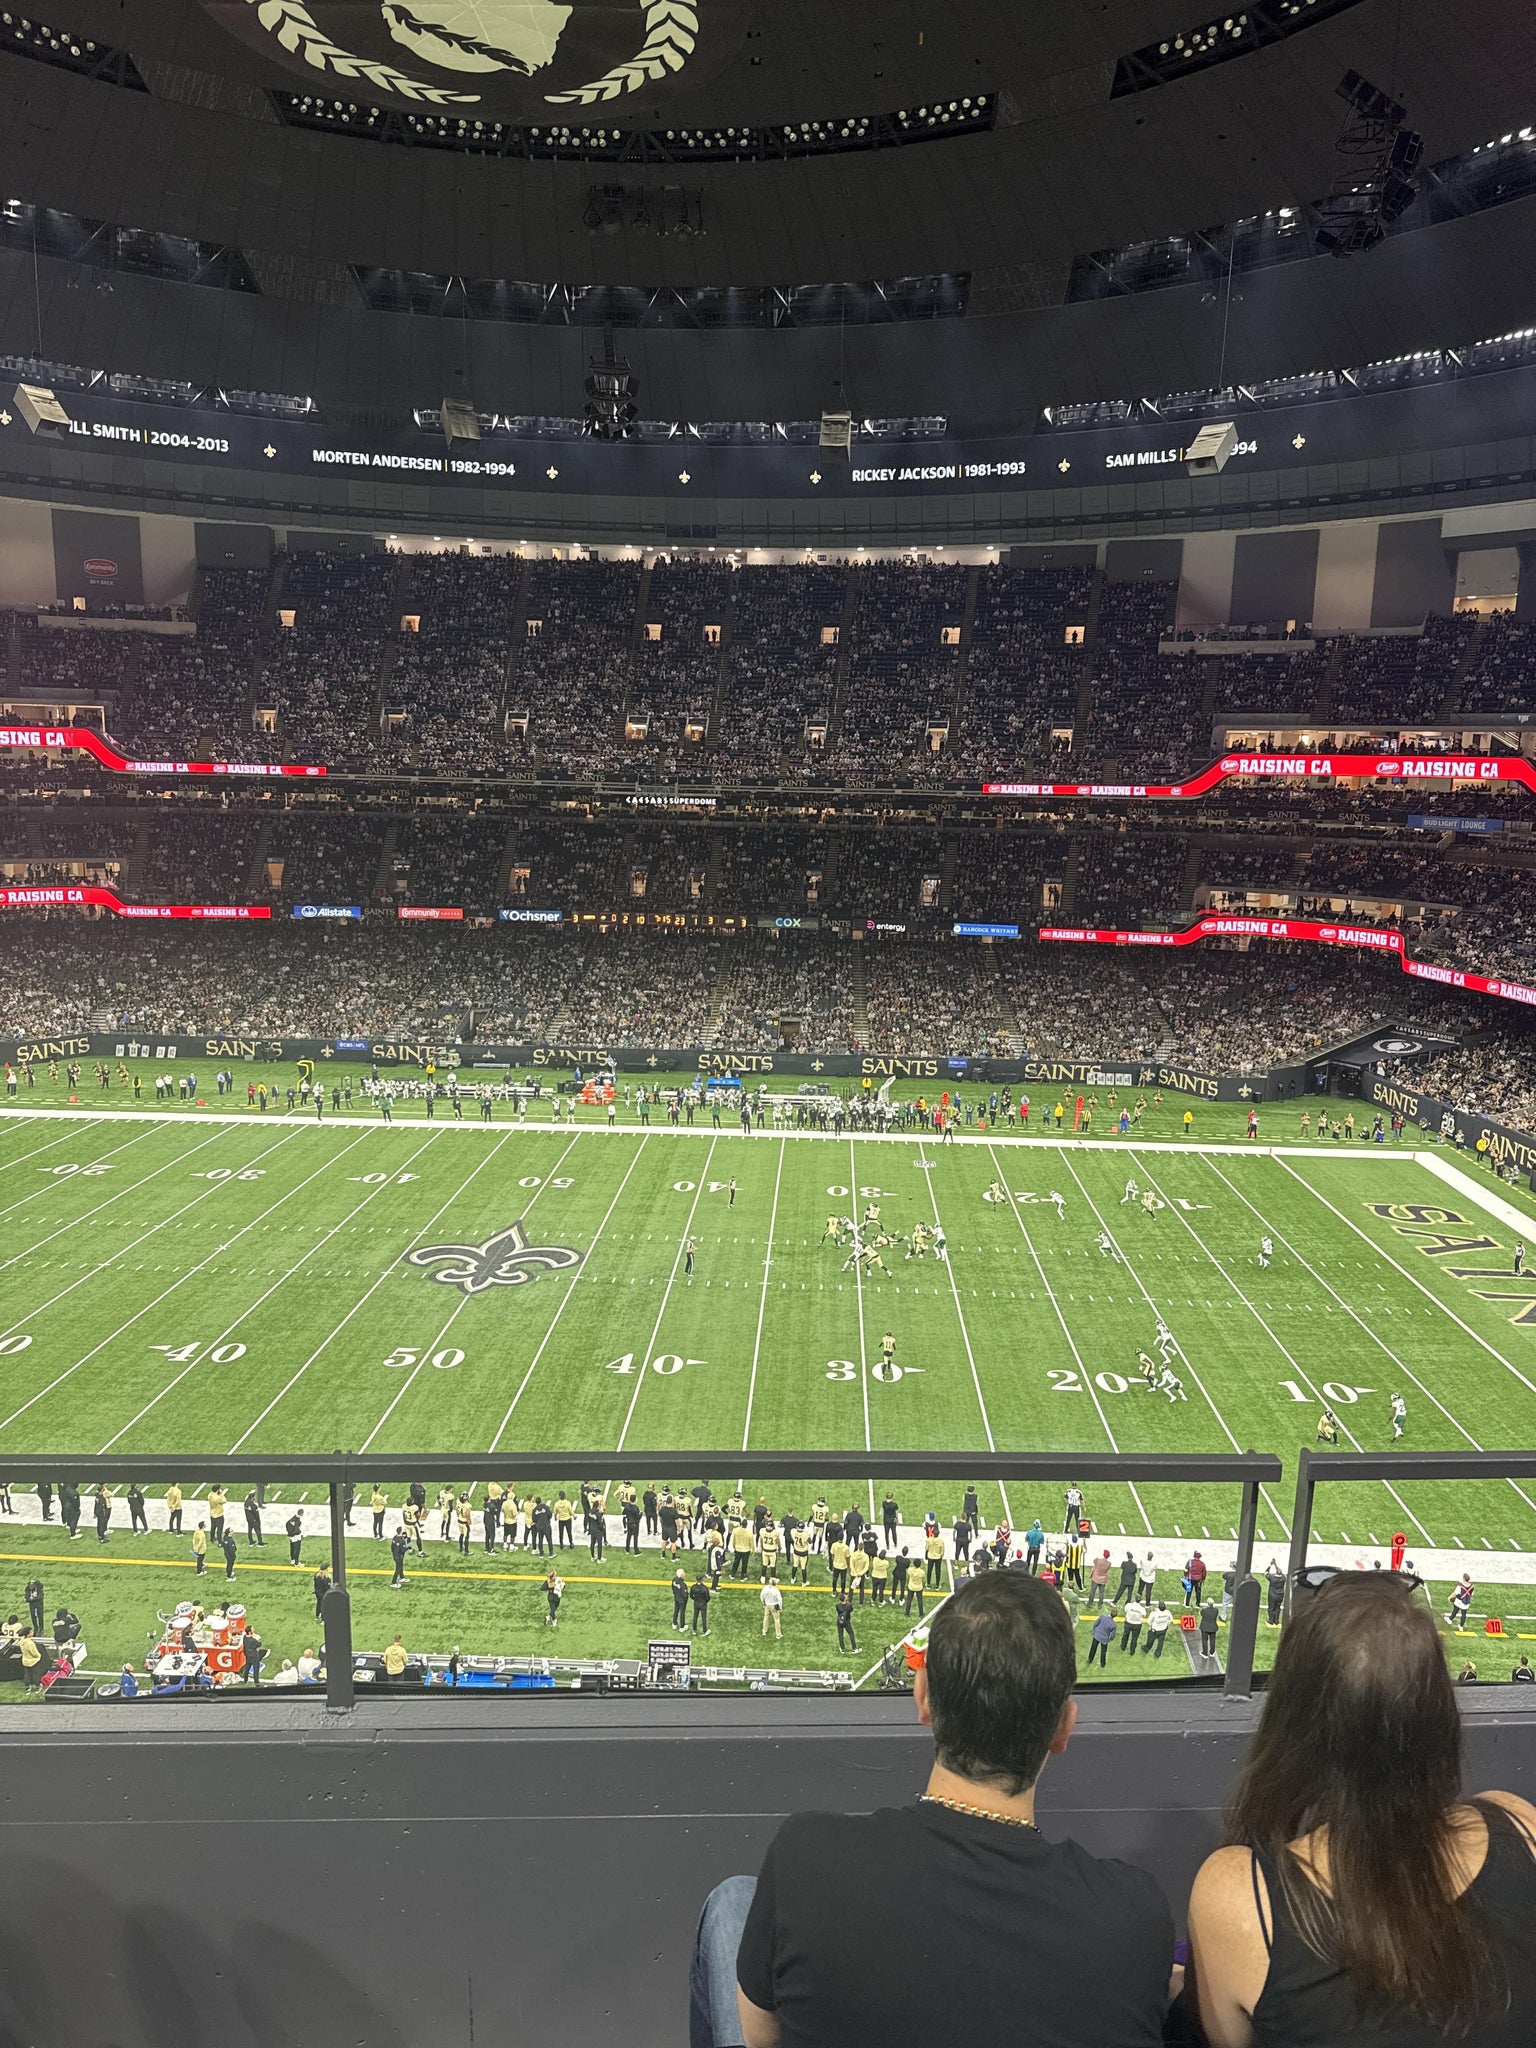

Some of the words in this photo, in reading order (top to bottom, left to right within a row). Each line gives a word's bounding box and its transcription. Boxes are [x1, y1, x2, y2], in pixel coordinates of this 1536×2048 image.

[69, 420, 90, 435] ILL
[93, 424, 141, 442] SMITH
[151, 432, 229, 452] 2004-2013
[313, 450, 369, 465] MORTEN
[372, 455, 442, 471] ANDERSEN
[450, 460, 515, 476] 1982-1994
[1106, 453, 1134, 468] SAM
[1137, 449, 1177, 465] MILLS
[852, 469, 896, 482] RICKEY
[898, 466, 956, 480] JACKSON
[964, 462, 1026, 477] 1981-1993
[135, 763, 173, 771] RAISING
[228, 765, 267, 773] RAISING
[365, 768, 397, 776] SAINTS
[1239, 759, 1305, 774] RAISING
[1311, 760, 1332, 774] CA
[1402, 761, 1475, 776] RAISING
[1480, 762, 1498, 777] CA
[506, 772, 537, 780] SAINTS
[575, 774, 606, 782] SAINTS
[778, 779, 808, 787] SAINTS
[913, 782, 944, 790] SAINTS
[1001, 785, 1038, 794] RAISING
[1092, 786, 1130, 795] RAISING
[625, 796, 668, 804] CAESARS
[669, 797, 717, 805] SUPERDOME
[1197, 809, 1228, 817] SAINTS
[1267, 811, 1299, 819] SAINTS
[1338, 813, 1370, 822] SAINTS
[1423, 819, 1437, 827] BUD
[1438, 820, 1458, 828] LIGHT
[1461, 820, 1486, 830] LOUNGE
[8, 891, 64, 902] RAISING
[68, 891, 83, 901] CA
[318, 908, 352, 917] Allstate
[402, 908, 440, 918] Community
[510, 910, 559, 922] Ochsner
[622, 915, 629, 924] 2
[636, 915, 645, 924] 10
[775, 917, 801, 928] COX
[876, 921, 906, 932] entergy
[1216, 920, 1268, 933] RAISING
[1271, 922, 1288, 934] CA
[1052, 931, 1084, 940] RAISING
[1086, 931, 1097, 940] CA
[1128, 934, 1161, 943] RAISING
[1163, 935, 1174, 943] CA
[1338, 929, 1387, 946] RAISING
[1390, 936, 1399, 948] CA
[1417, 964, 1452, 982] RAISING
[1453, 973, 1465, 986] CA
[17, 1037, 90, 1063] SAINTS
[698, 1054, 774, 1071] SAINTS
[861, 1057, 938, 1076] SAINTS
[1159, 1068, 1218, 1097] SAINTS
[1373, 1083, 1418, 1117] SAINTS
[52, 1163, 117, 1176] 20
[205, 1168, 267, 1180] 30
[362, 1172, 421, 1184] 40
[518, 1176, 575, 1188] 50
[673, 1180, 728, 1193] 40
[827, 1185, 882, 1198] 30
[164, 1341, 247, 1363] 40
[383, 1347, 465, 1368] 50
[605, 1353, 684, 1375] 40
[825, 1360, 903, 1383] 30
[1046, 1369, 1129, 1394] 20
[1278, 1381, 1358, 1404] 10
[730, 1505, 740, 1515] 83
[815, 1511, 824, 1520] 12
[1079, 1521, 1090, 1533] 2
[764, 1536, 774, 1545] 73
[795, 1536, 803, 1546] 74
[1183, 1617, 1195, 1629] 20
[1490, 1621, 1501, 1633] 10
[217, 1651, 233, 1668] G
